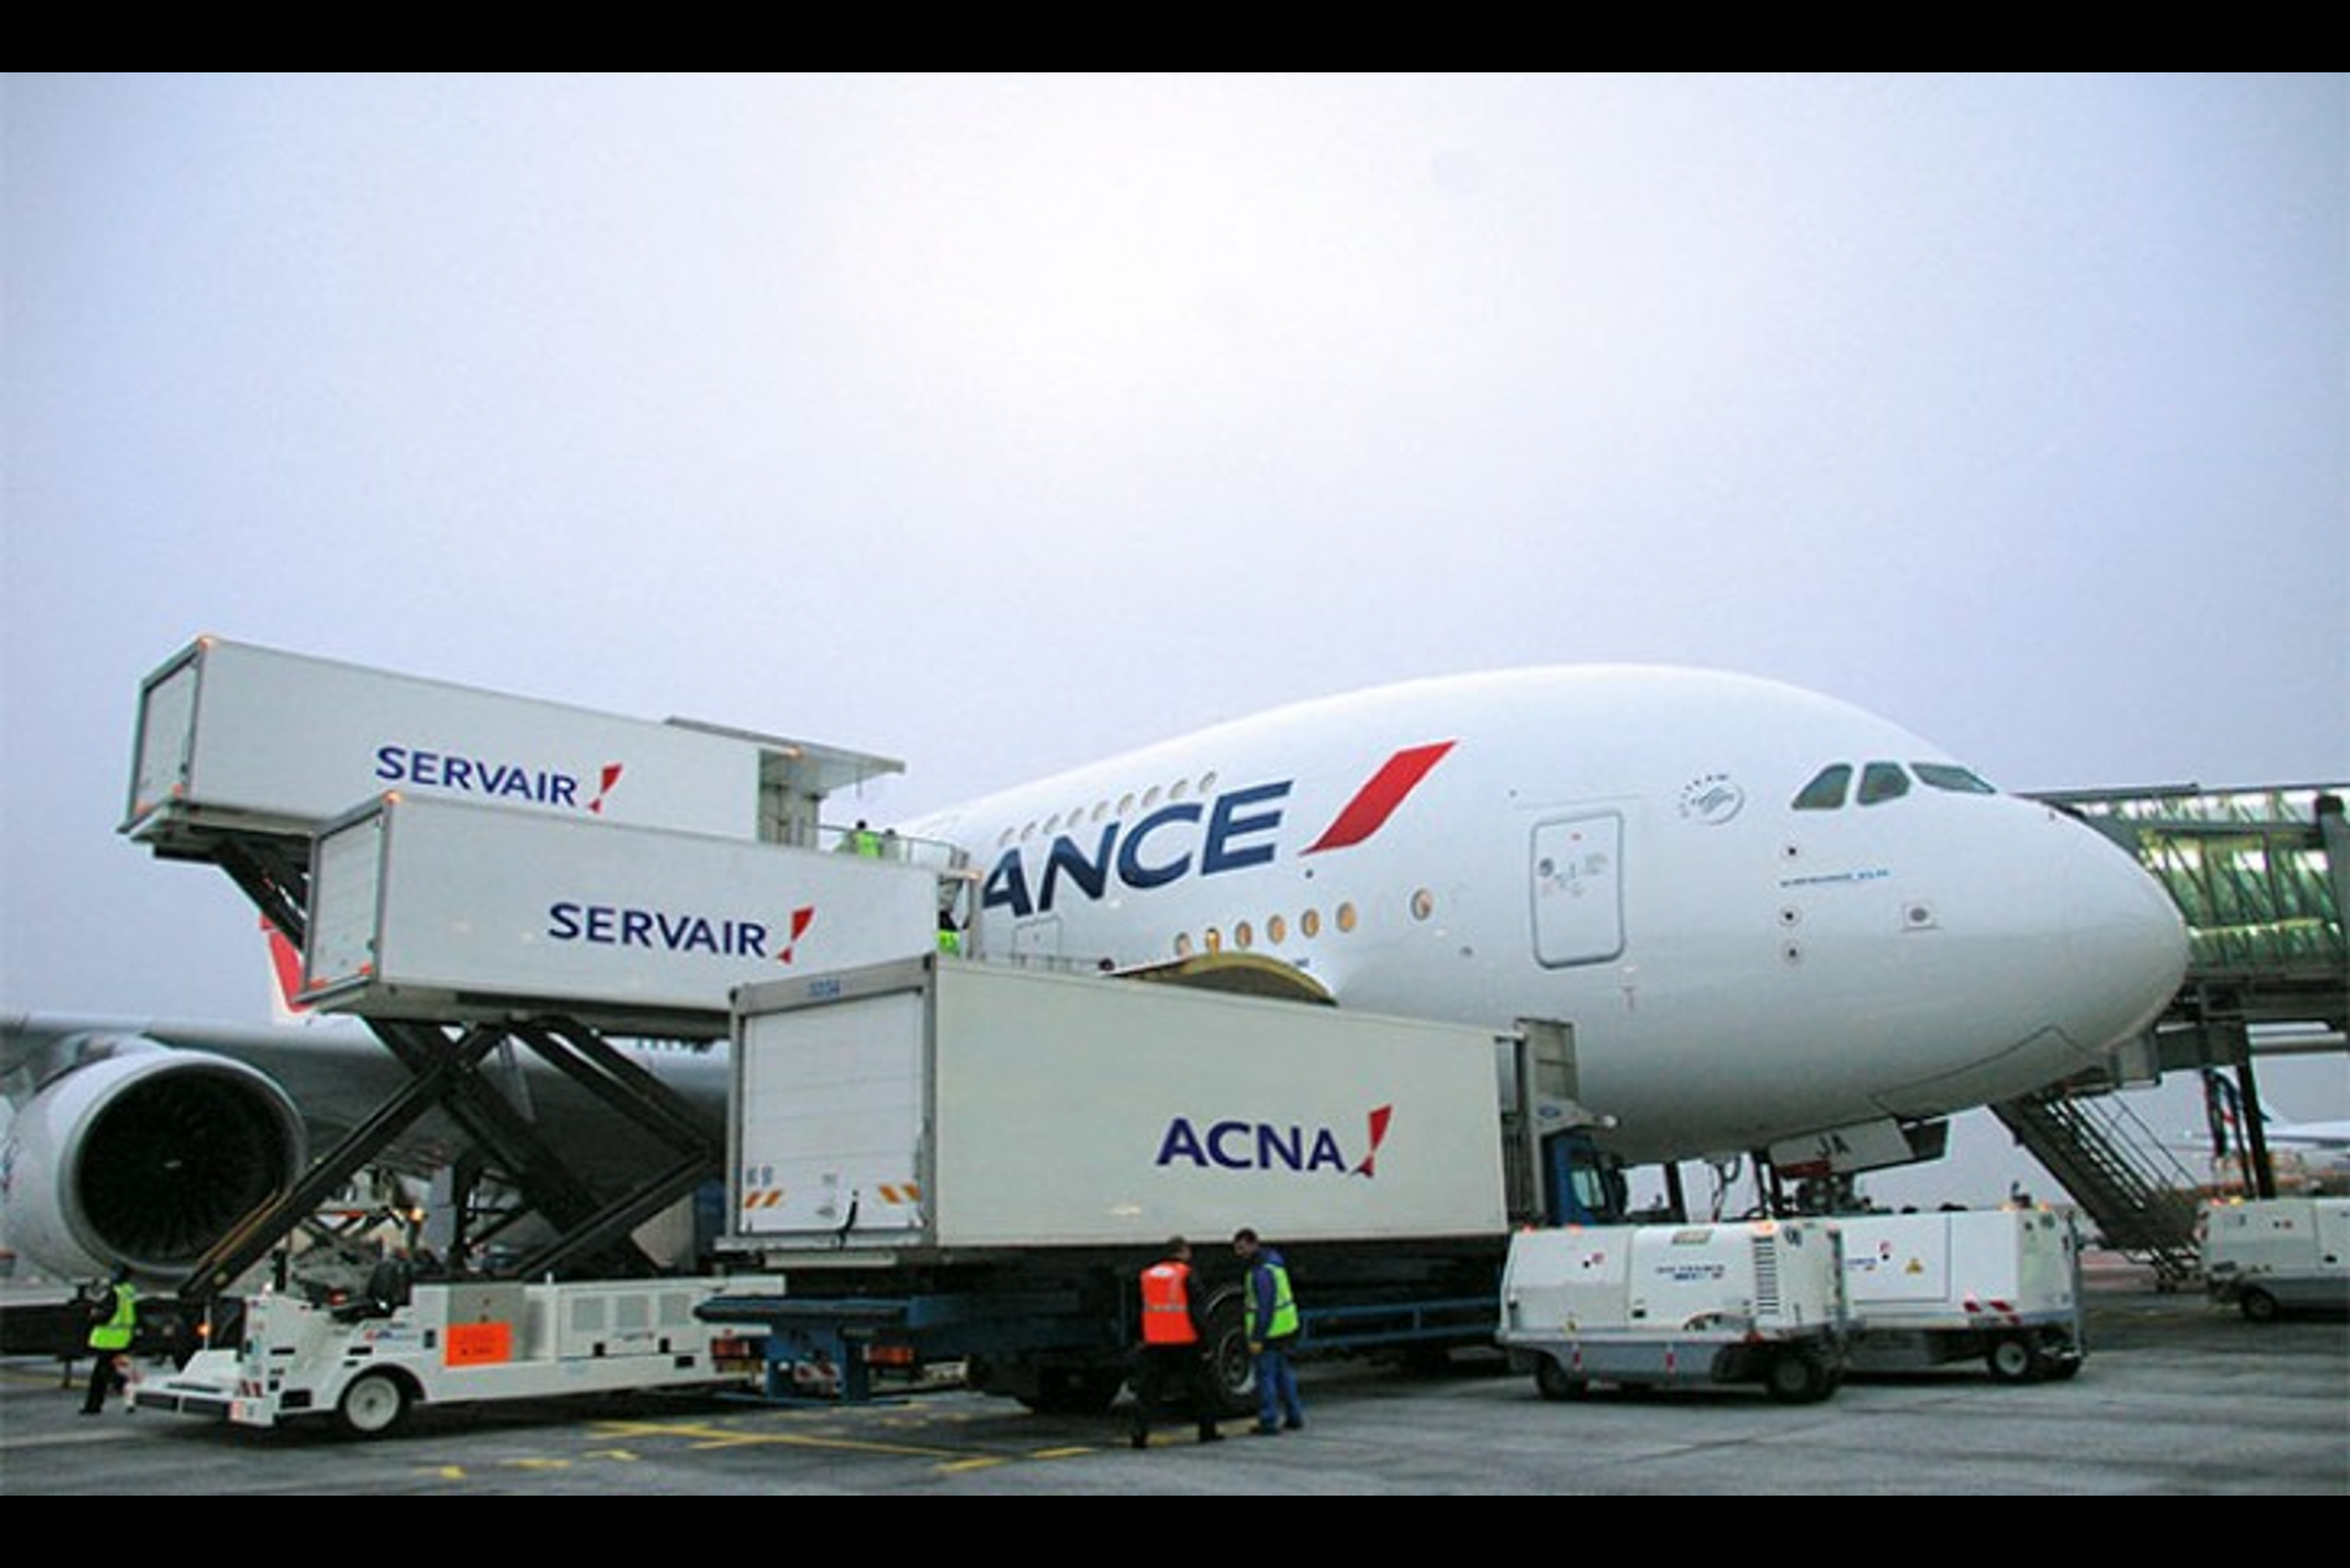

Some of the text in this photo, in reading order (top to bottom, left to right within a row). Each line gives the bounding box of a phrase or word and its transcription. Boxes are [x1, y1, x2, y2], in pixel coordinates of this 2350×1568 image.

[375, 746, 577, 807] SERVAIR
[547, 902, 767, 958] SERVAIR
[1155, 1116, 1348, 1173] ACNA
